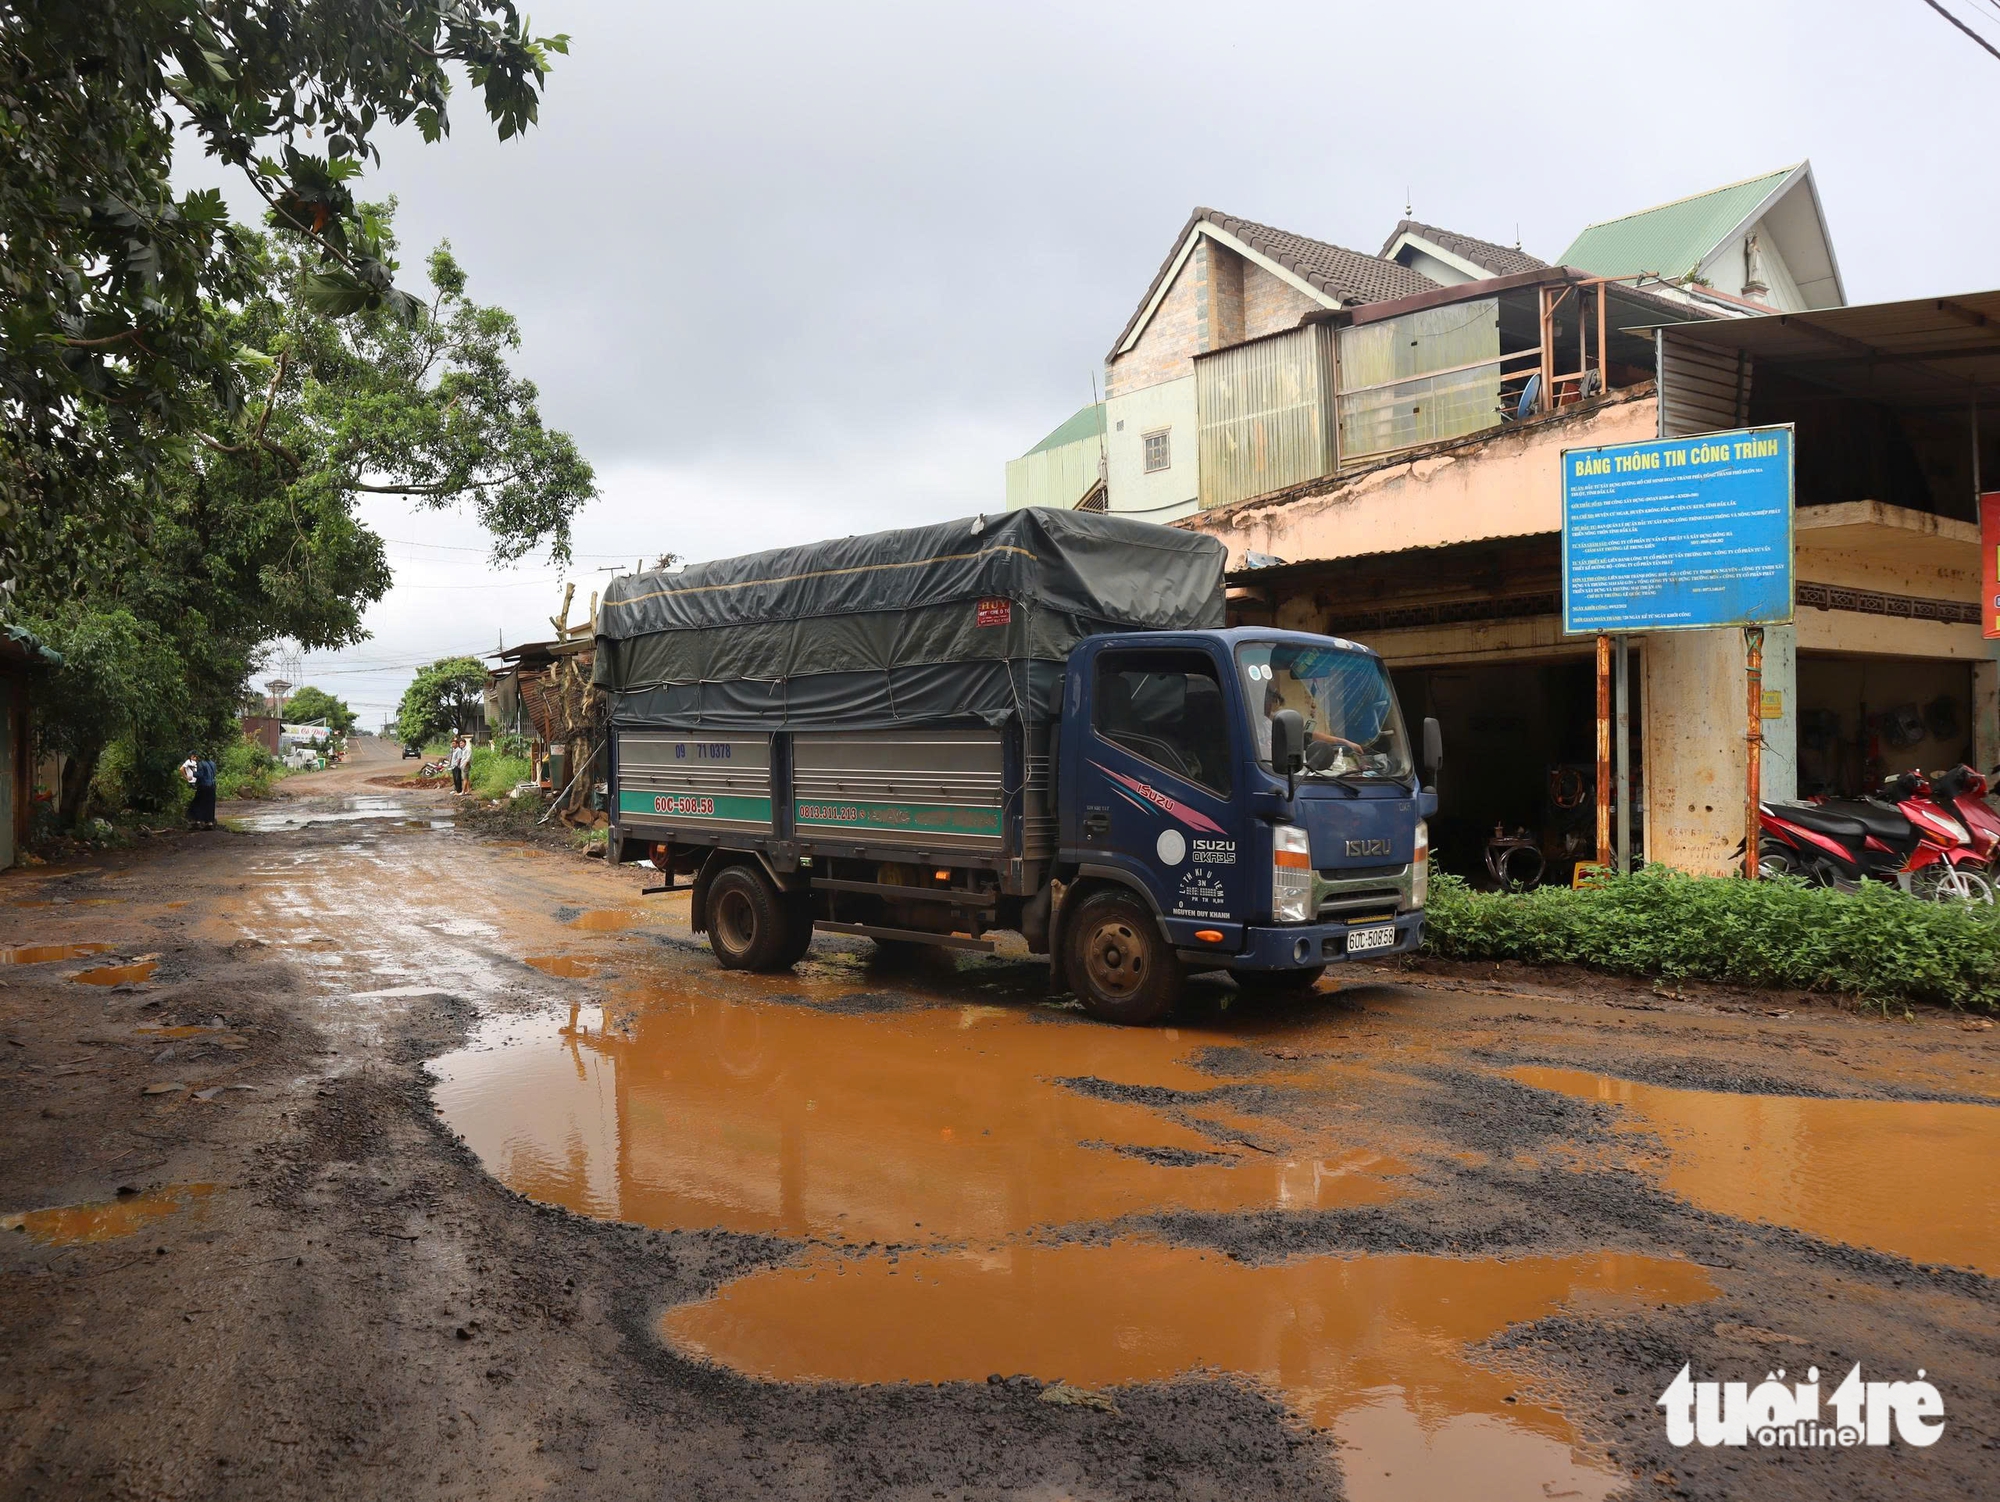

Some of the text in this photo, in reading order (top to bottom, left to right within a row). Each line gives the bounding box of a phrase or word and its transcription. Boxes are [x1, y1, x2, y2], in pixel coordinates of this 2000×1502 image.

[1576, 438, 1778, 477] BẢNG THÔNG TIN CÔNG TRÌNH
[710, 744, 730, 758] 0378
[654, 796, 714, 815] 60C-508.58
[1137, 784, 1174, 811] ISUZU
[800, 805, 857, 822] 0813.311.213
[1193, 840, 1235, 851] ISUZU
[1346, 840, 1390, 856] ISUZU
[1349, 928, 1394, 949] 60C-508.58
